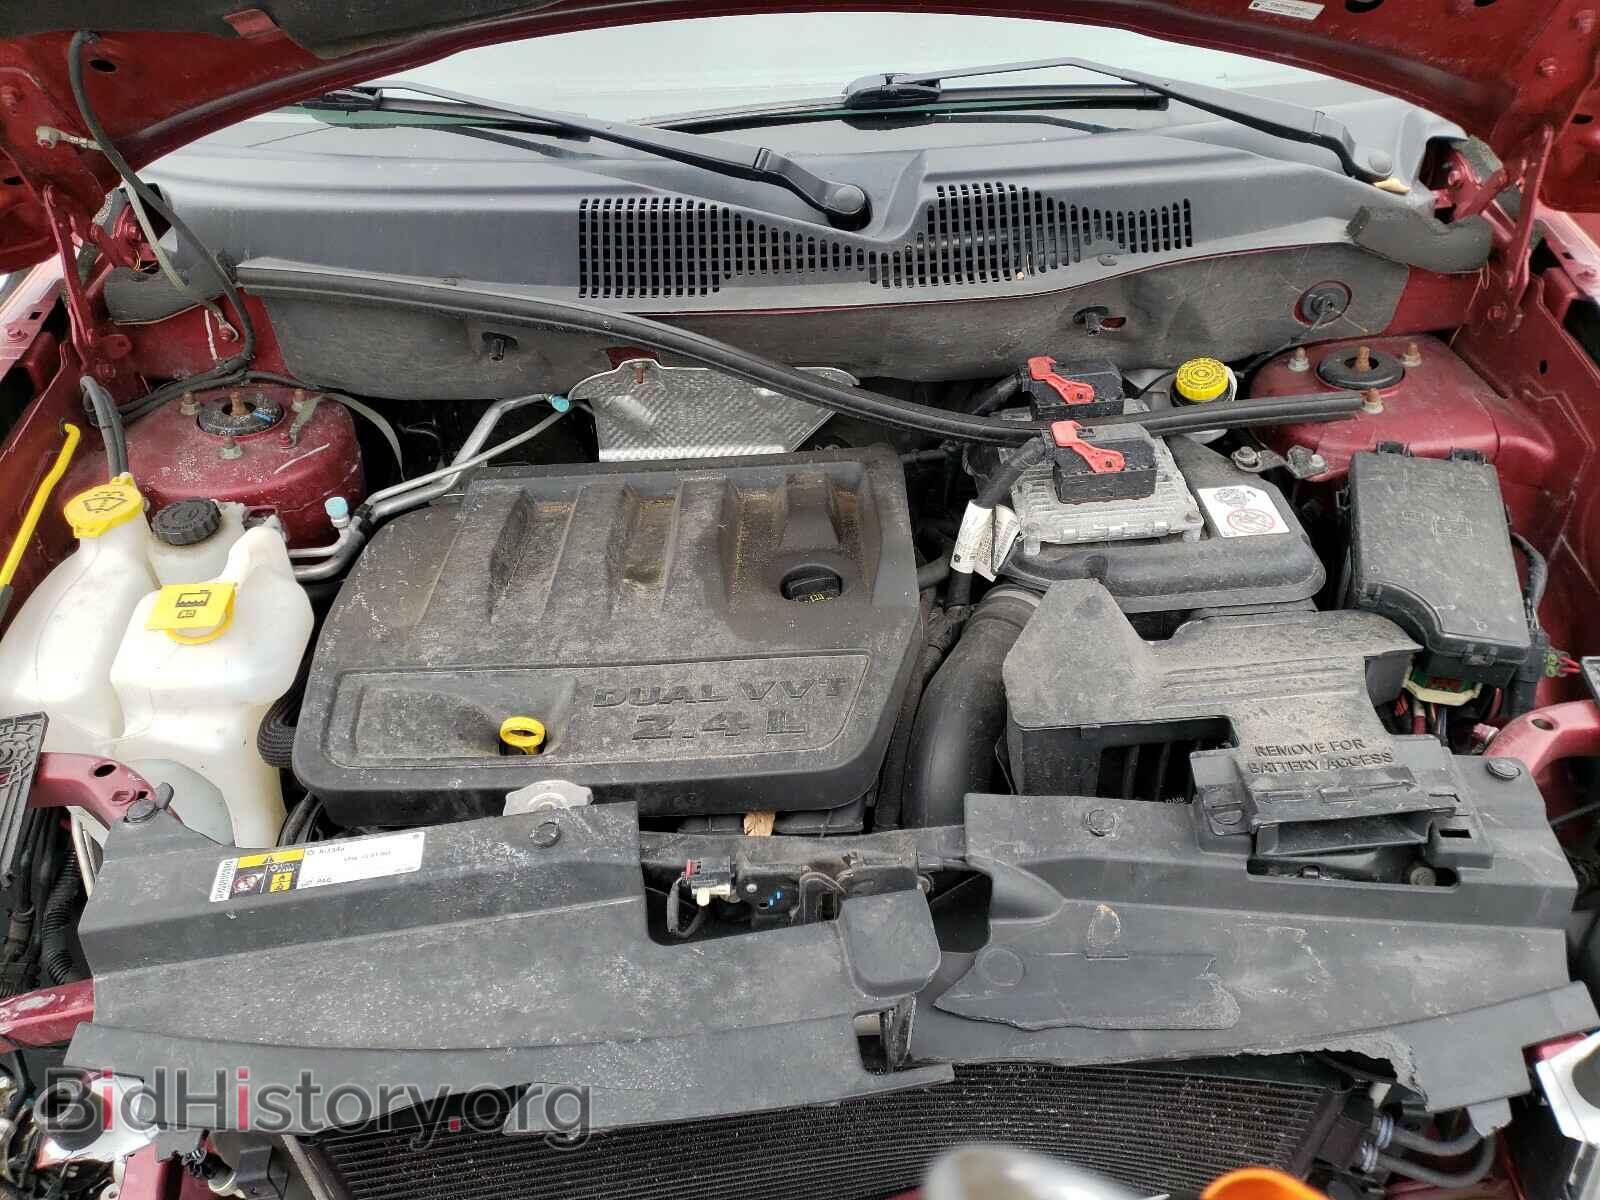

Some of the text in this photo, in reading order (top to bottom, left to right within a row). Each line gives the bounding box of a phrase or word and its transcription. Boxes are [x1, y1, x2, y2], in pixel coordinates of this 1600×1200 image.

[591, 678, 850, 707] DUAL VVT
[1254, 738, 1366, 757] REMOVE FOR
[1249, 752, 1393, 774] BATTERY ACCESS
